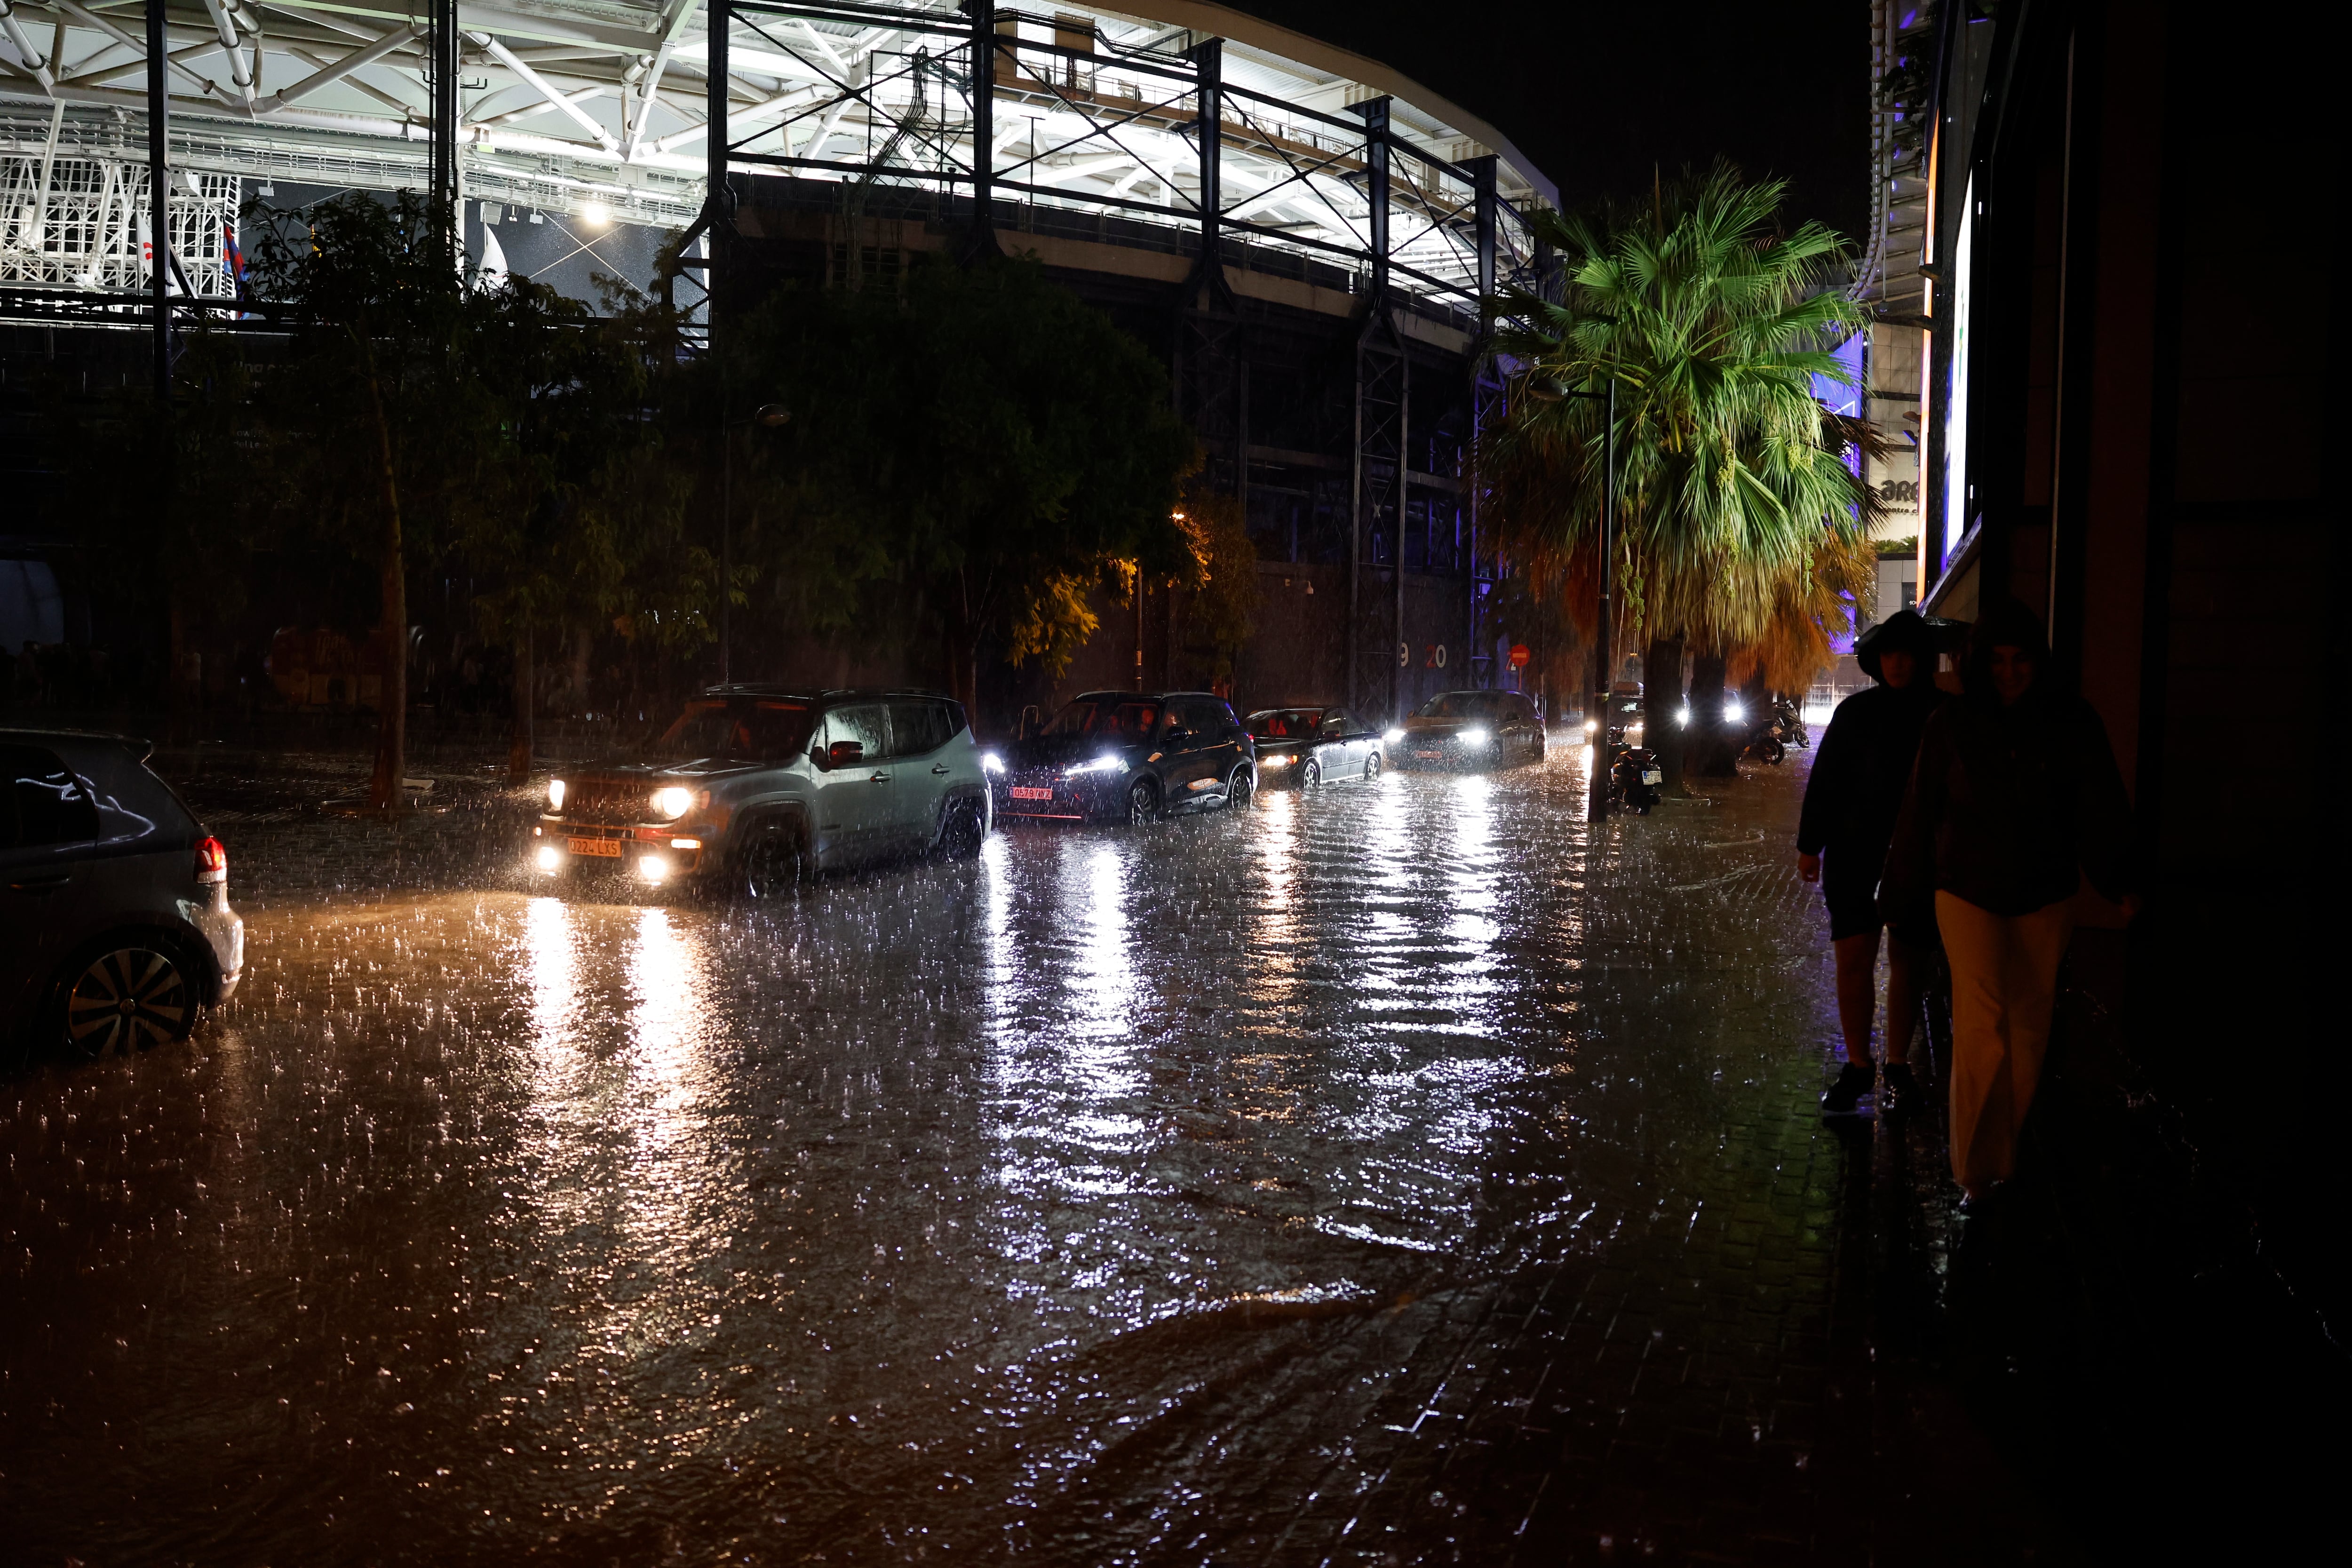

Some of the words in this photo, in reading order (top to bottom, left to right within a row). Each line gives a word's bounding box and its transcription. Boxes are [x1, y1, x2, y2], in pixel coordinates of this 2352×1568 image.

[1425, 644, 1447, 668] 20
[1015, 789, 1034, 797] 0579
[570, 840, 594, 852] 0224
[598, 842, 617, 855] LXS
